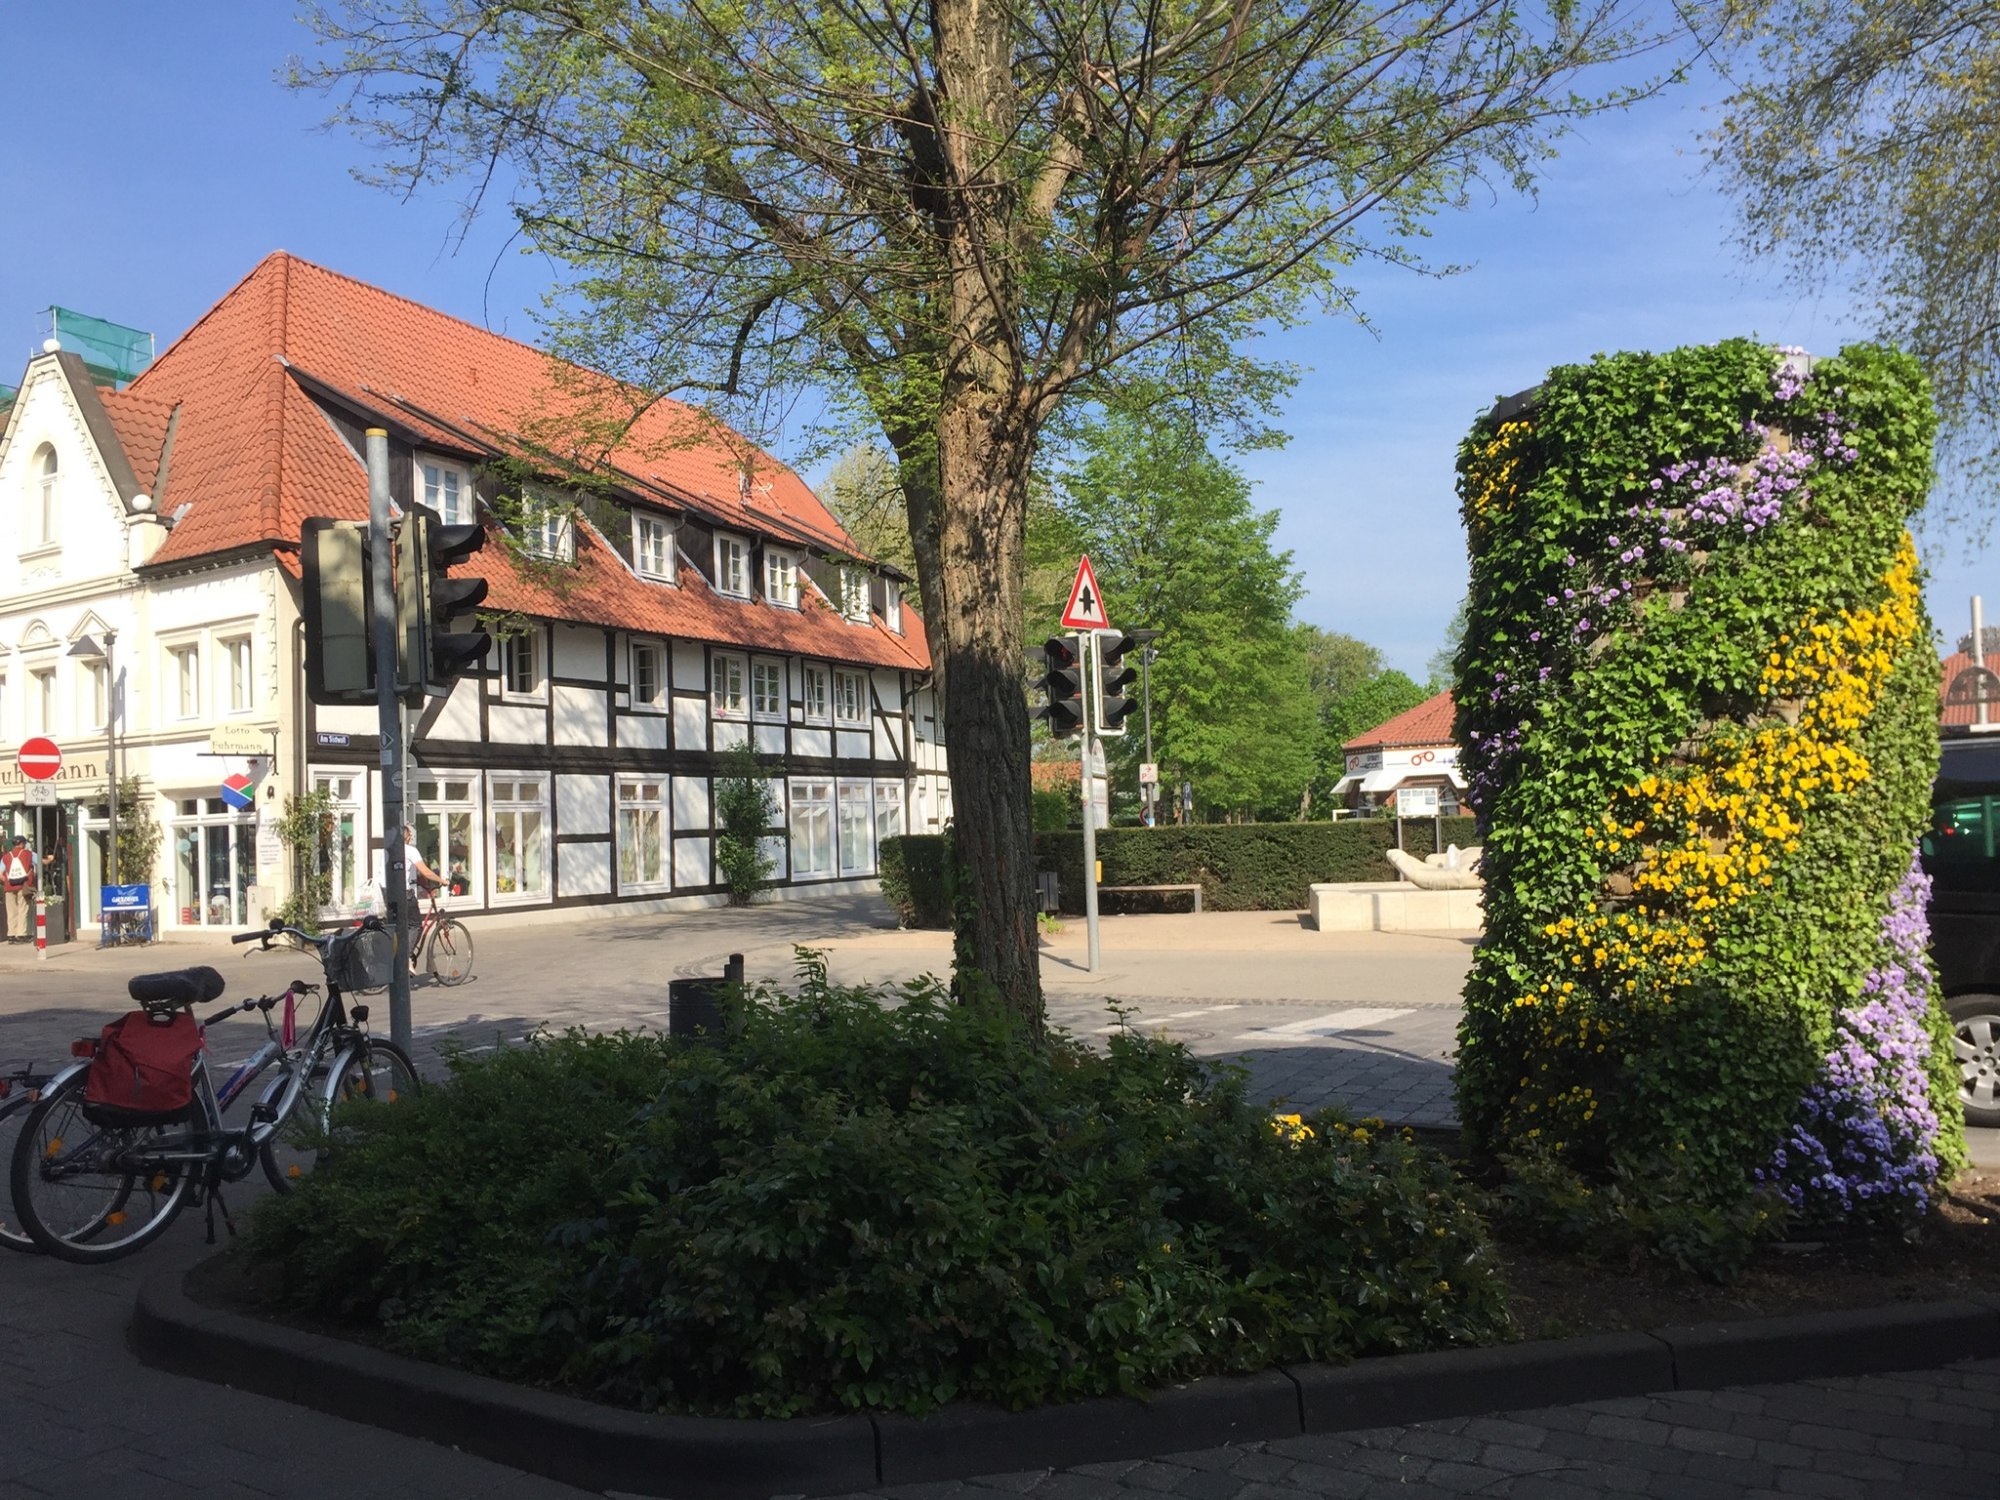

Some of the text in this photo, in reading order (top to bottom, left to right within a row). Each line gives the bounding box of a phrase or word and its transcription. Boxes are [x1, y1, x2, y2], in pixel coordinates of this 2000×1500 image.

[225, 726, 250, 734] Lotto
[212, 741, 262, 750] Fuhrmann
[1, 762, 97, 785] uhann
